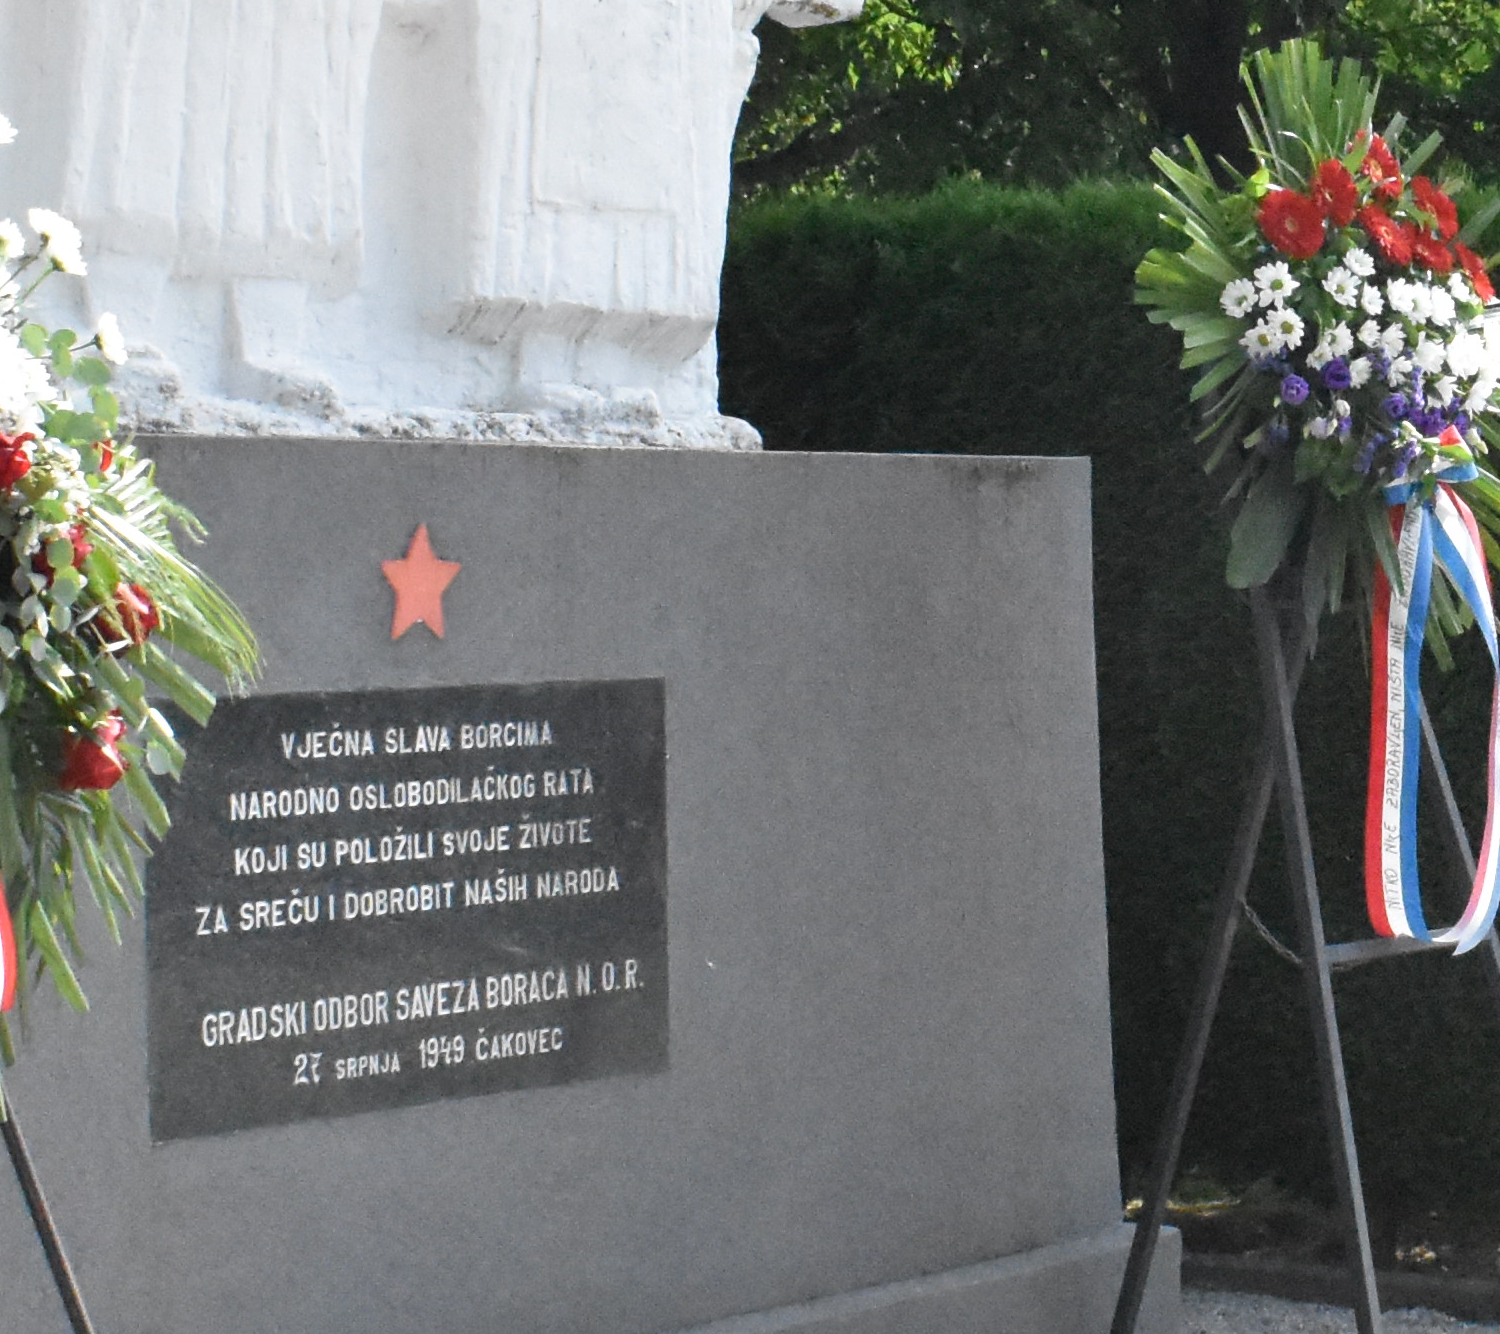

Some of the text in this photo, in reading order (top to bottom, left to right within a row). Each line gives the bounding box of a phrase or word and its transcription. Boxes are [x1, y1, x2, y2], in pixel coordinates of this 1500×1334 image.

[280, 720, 553, 759] VJEČNA SLAVA BORCIMA
[229, 785, 340, 821] NARODNO
[543, 767, 595, 798] RATA
[234, 813, 592, 876] KOJI SU POLOŽILI SVOJE ŽIVOTE
[195, 906, 229, 936] ZA
[328, 894, 336, 921] I
[344, 881, 455, 920] DOBROBIT
[464, 868, 528, 908] NAŠIH
[536, 866, 620, 900] NARODA
[202, 1001, 308, 1047] GRADSKI
[313, 990, 390, 1032] ODBOR
[396, 978, 480, 1021] SAVEZA
[485, 967, 570, 1010] BORACA
[625, 958, 645, 990] R.
[293, 1027, 564, 1086] 27 SRPNJA 1949 ČAKOVEC
